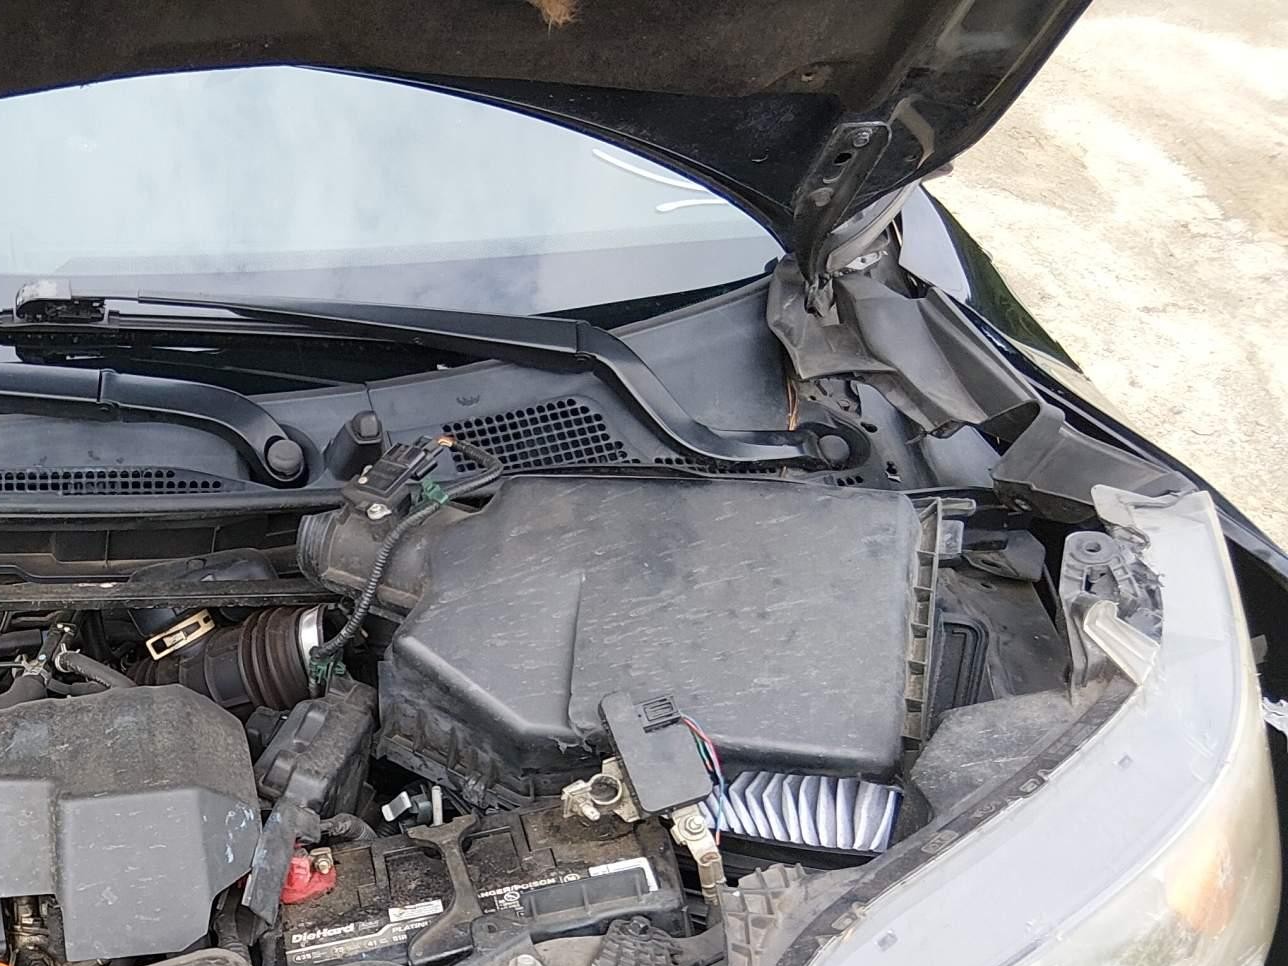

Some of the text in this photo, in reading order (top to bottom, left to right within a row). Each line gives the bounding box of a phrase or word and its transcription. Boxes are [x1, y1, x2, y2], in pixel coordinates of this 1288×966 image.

[478, 877, 557, 898] NGER/POISON
[291, 923, 355, 944] DieHard
[391, 919, 432, 934] PLATINU
